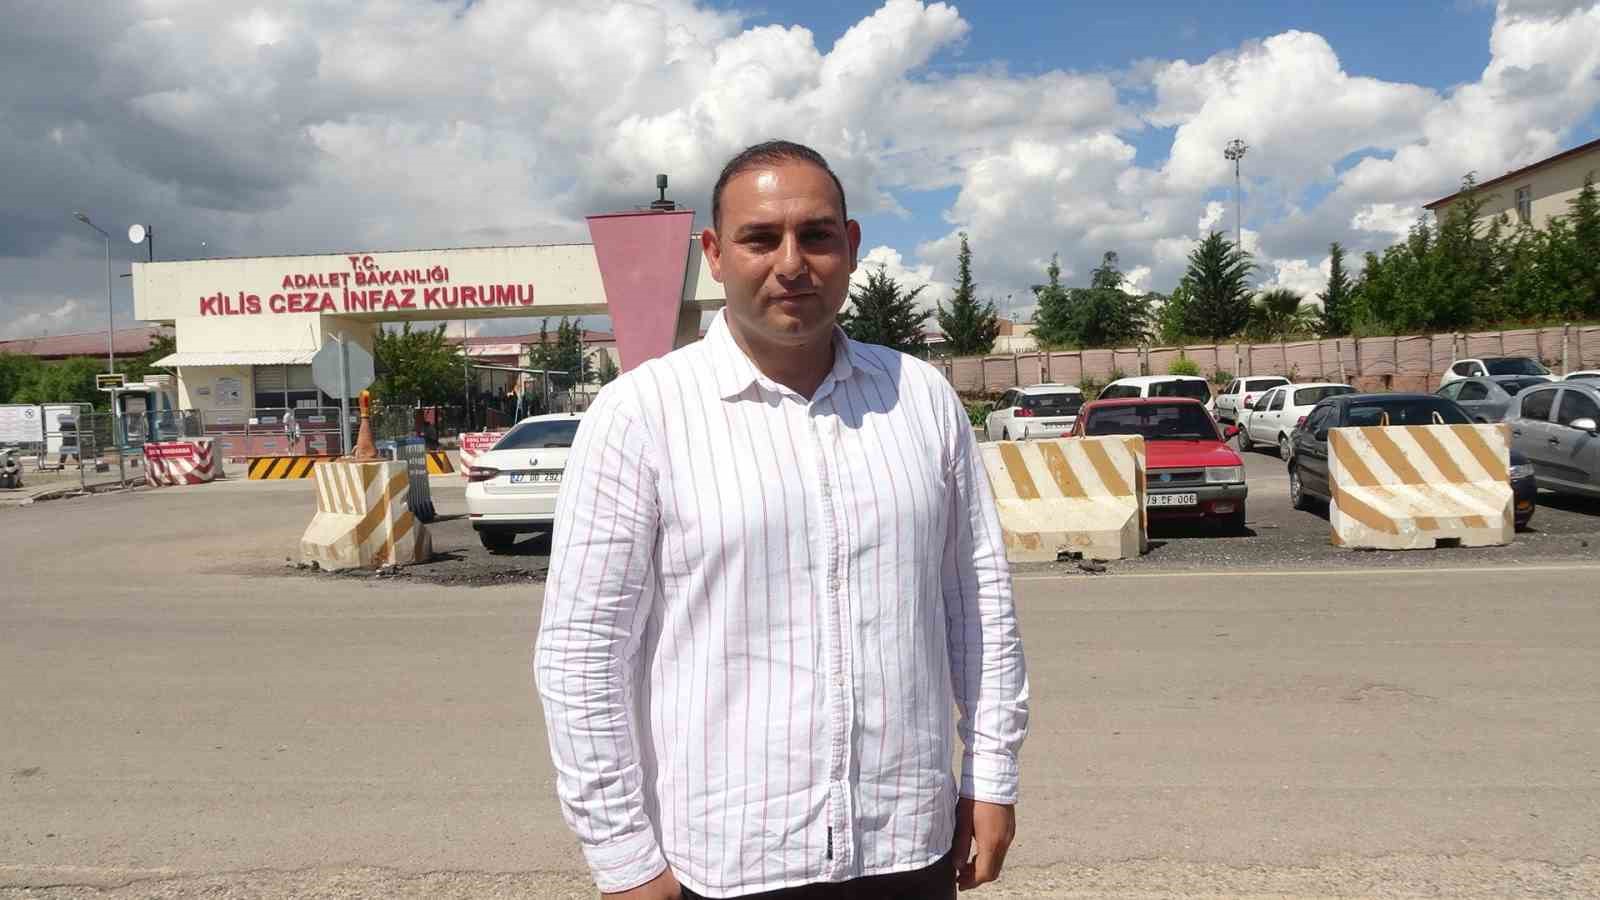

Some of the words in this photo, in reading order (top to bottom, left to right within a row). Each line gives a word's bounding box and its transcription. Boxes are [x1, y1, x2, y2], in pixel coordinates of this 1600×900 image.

[349, 255, 379, 271] T.C.
[282, 272, 350, 289] ADALET
[354, 266, 449, 286] BAKANLIĞI
[199, 291, 262, 316] KİLİS
[269, 292, 337, 314] CEZA
[343, 286, 416, 311] İNFAZ
[423, 284, 534, 309] KURUMU
